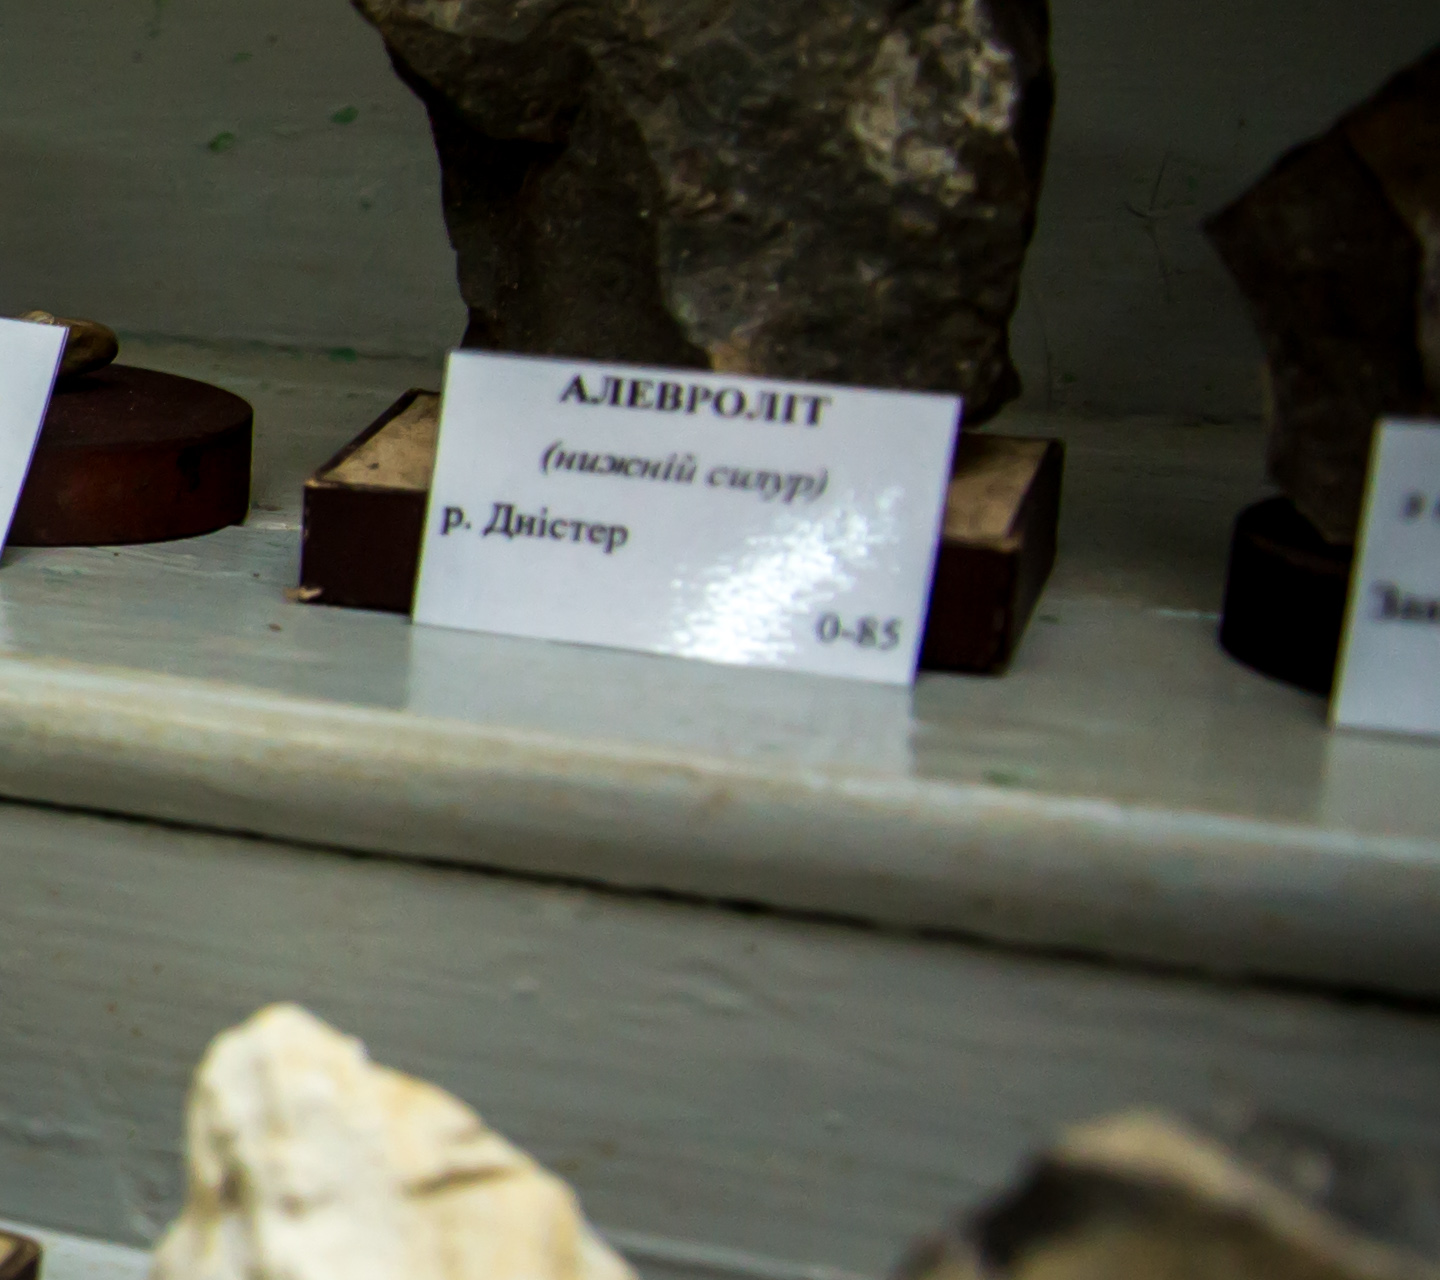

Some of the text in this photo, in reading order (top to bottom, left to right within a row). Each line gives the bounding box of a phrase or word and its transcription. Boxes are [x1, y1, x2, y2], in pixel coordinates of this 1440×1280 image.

[559, 374, 833, 428] АЛЕВРОЛІТ
[540, 440, 830, 503] (нижній силур)
[439, 502, 629, 555] р. Дністер
[814, 613, 901, 652] 0-85
